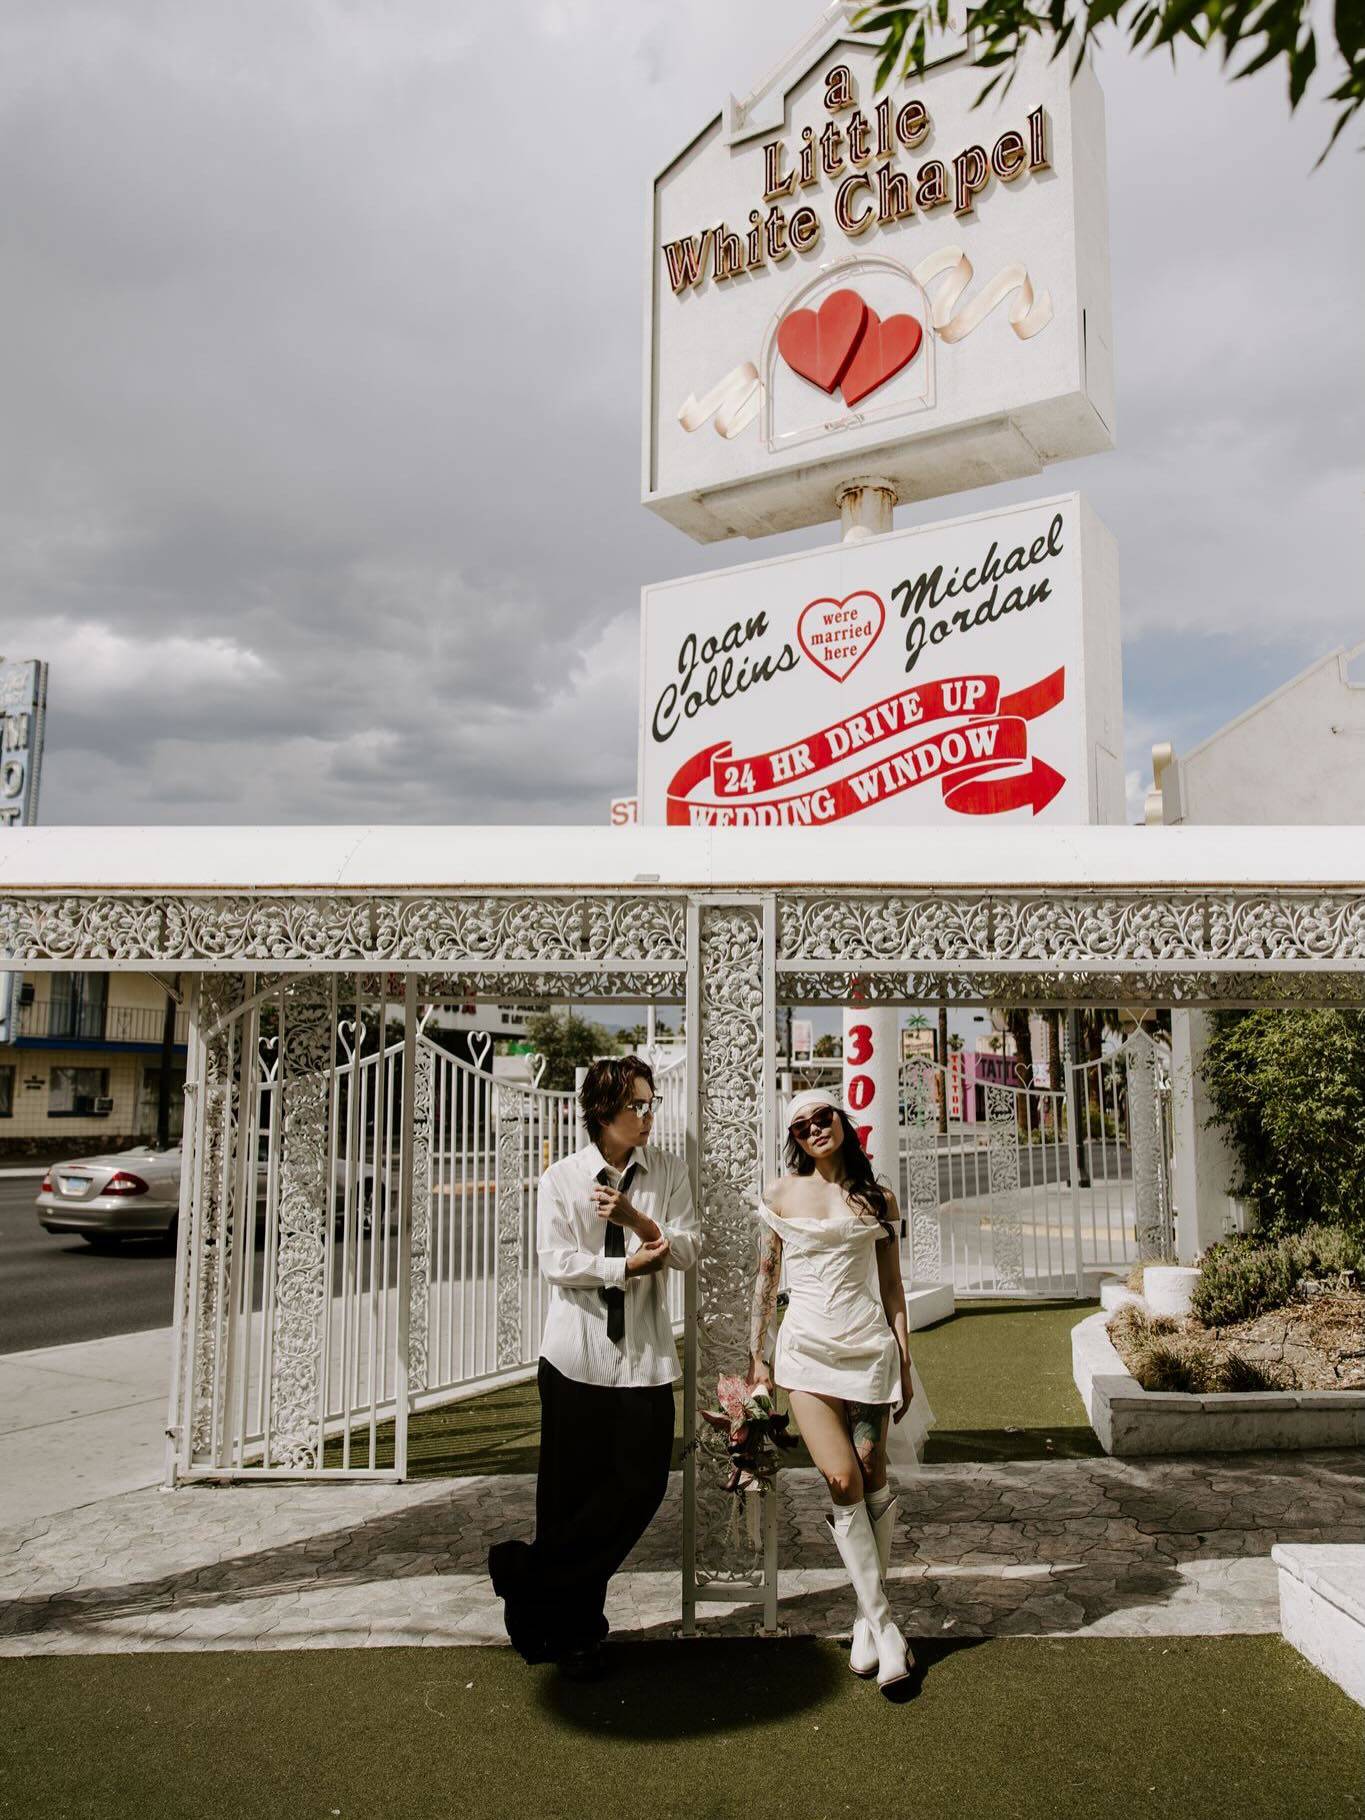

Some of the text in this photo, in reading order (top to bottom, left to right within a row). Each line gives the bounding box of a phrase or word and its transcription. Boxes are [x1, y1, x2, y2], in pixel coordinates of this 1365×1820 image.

[824, 64, 856, 112] a
[762, 98, 930, 202] Little
[662, 104, 1052, 296] White Chapel
[891, 513, 1064, 618] Michael
[678, 610, 770, 676] Joan
[811, 620, 872, 646] married
[823, 608, 858, 626] were
[823, 644, 858, 661] here
[904, 578, 1053, 673] Jordan
[652, 642, 801, 742] Collins
[723, 678, 987, 793] 24 HR DRIVE UP
[688, 724, 1000, 826] WEDDING WINDOW
[951, 1054, 959, 1115] TATTOO
